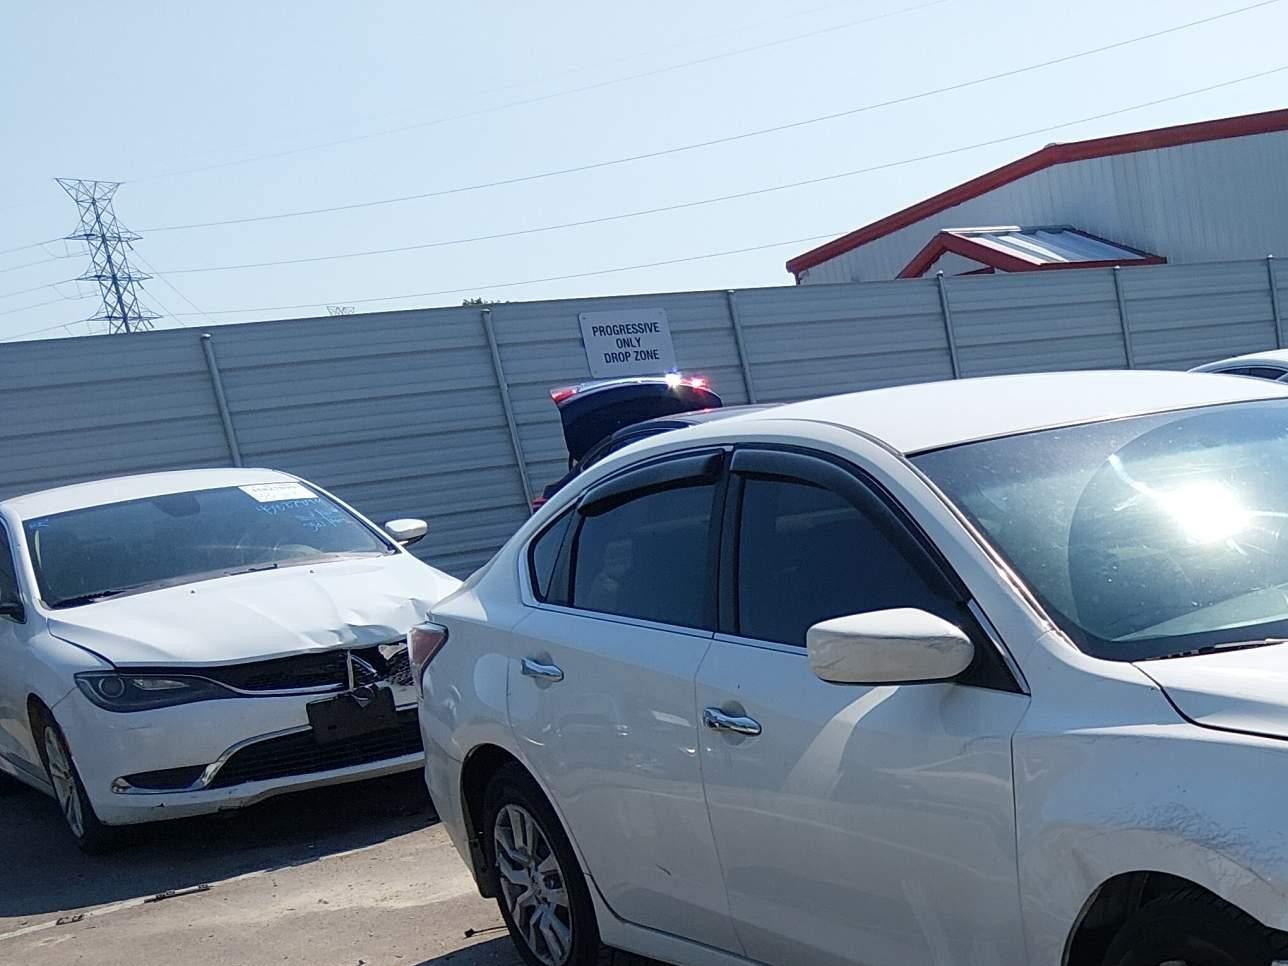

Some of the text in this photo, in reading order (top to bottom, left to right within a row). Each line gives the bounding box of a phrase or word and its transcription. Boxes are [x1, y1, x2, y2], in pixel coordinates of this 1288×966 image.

[591, 321, 660, 337] PROGRESSIVE
[615, 337, 641, 349] ONLY
[604, 349, 660, 364] DROP ZONE
